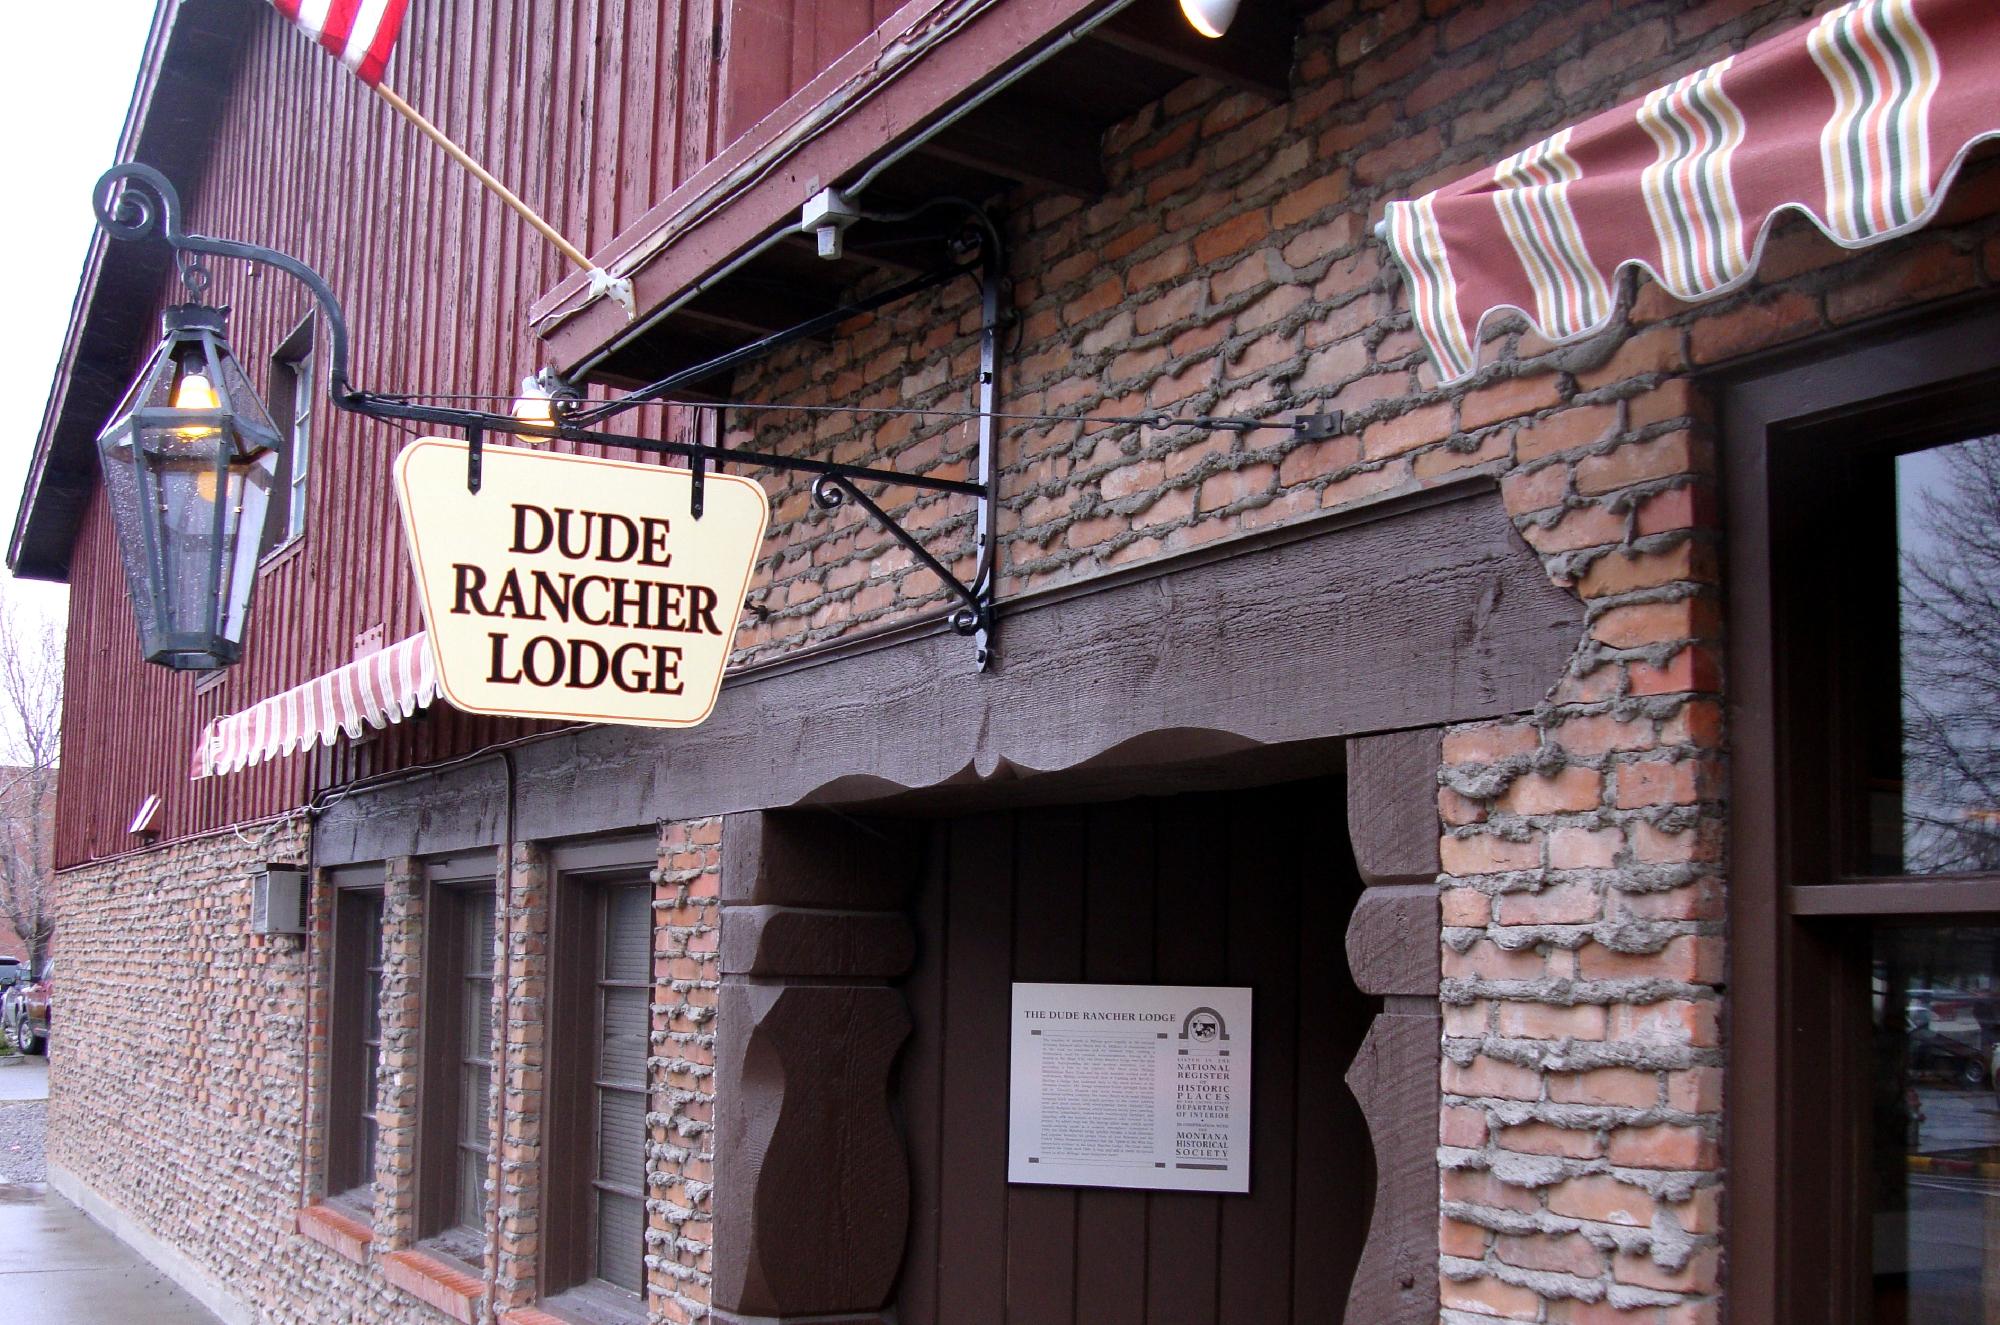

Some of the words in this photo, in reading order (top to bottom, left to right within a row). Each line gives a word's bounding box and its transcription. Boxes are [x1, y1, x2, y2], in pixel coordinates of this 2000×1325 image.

[508, 503, 672, 567] DUDE
[450, 563, 722, 635] RANCHER
[486, 632, 685, 695] LODGE
[1024, 1010, 1046, 1019] THE
[1049, 1011, 1079, 1020] DUDE
[1083, 1011, 1136, 1021] RANCHER
[1139, 1012, 1176, 1022] LODGE
[1177, 1063, 1230, 1071] NATIONAL
[1177, 1071, 1230, 1080] REGISTER
[1177, 1084, 1230, 1093] HISTORIC
[1177, 1092, 1230, 1100] PLACES
[1176, 1103, 1229, 1111] DEPARTMENT
[1190, 1111, 1229, 1119] INTERIOR
[1176, 1131, 1228, 1140] MONTANA
[1176, 1140, 1229, 1149] HISTORICAL
[1175, 1148, 1228, 1157] SOCIETY
